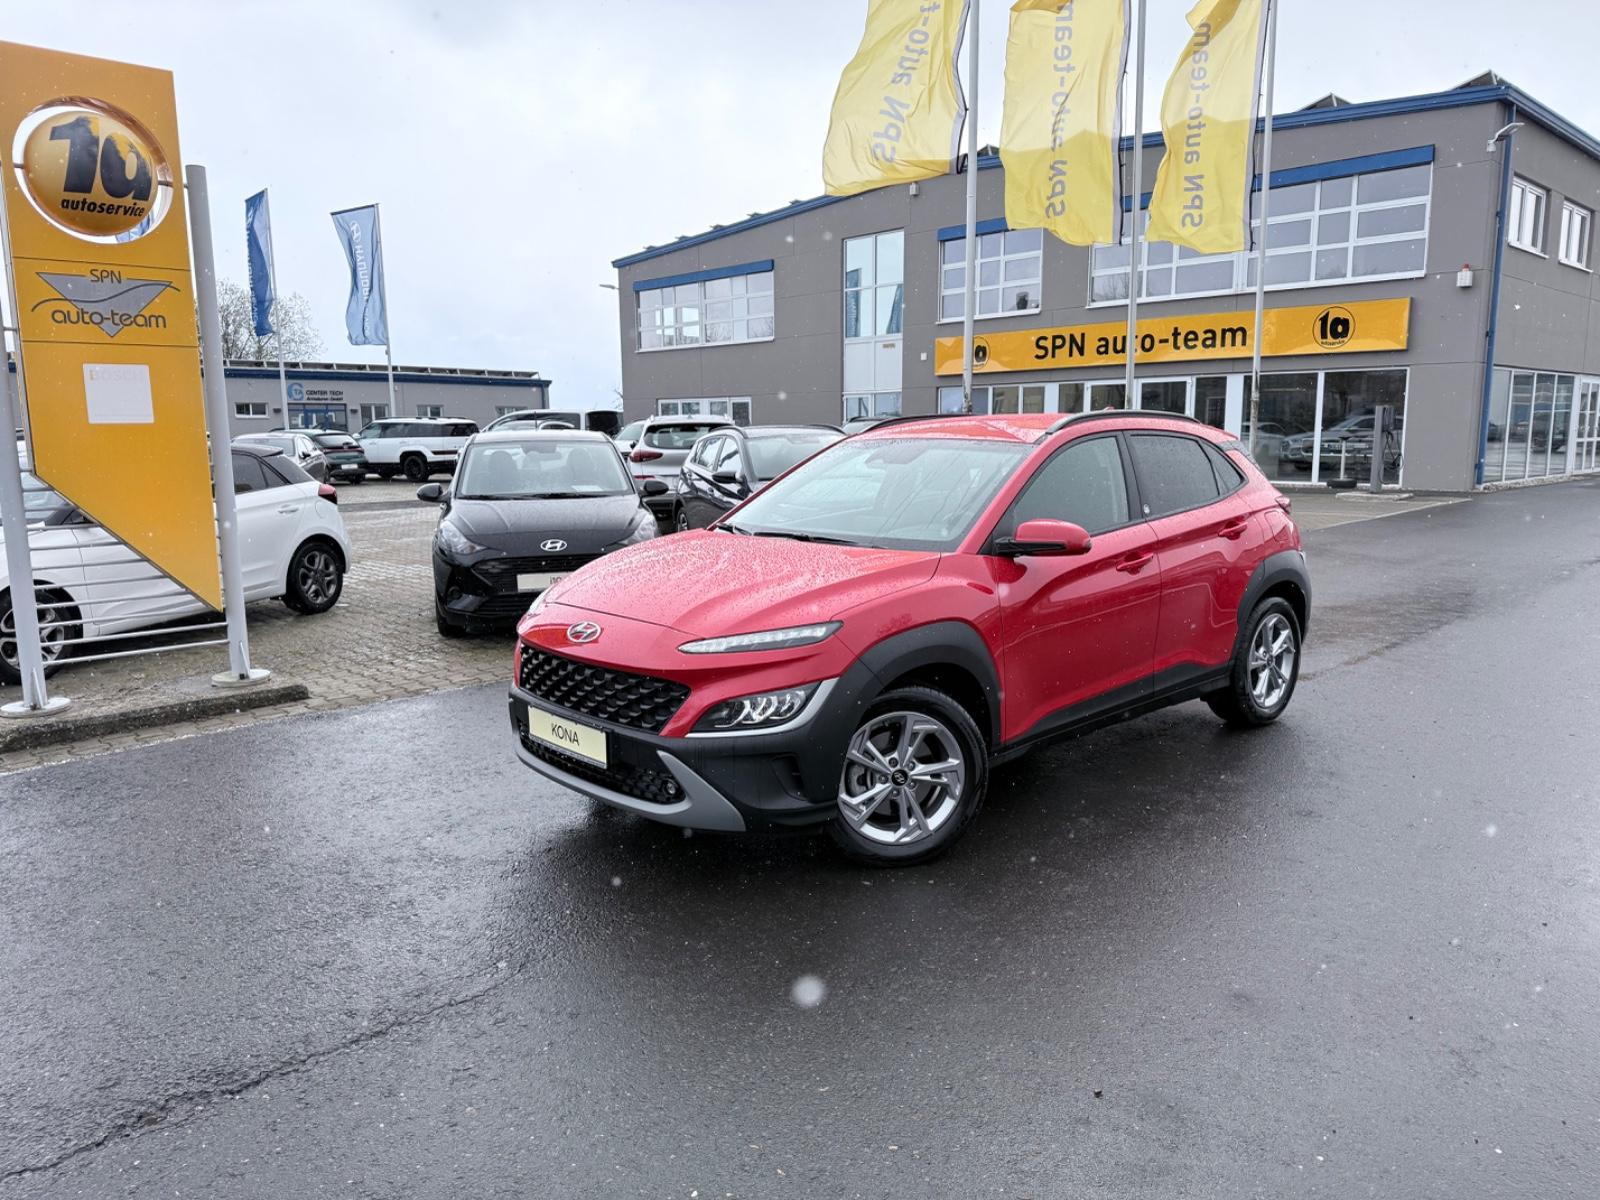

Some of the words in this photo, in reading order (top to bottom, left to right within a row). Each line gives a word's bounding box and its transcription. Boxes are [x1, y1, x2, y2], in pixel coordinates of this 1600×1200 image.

[61, 198, 145, 216] autoservice
[89, 268, 122, 284] SPN
[51, 308, 167, 328] auto-team
[1034, 332, 1086, 360] SPN
[1096, 326, 1248, 356] auo-team
[551, 723, 580, 747] KONA
